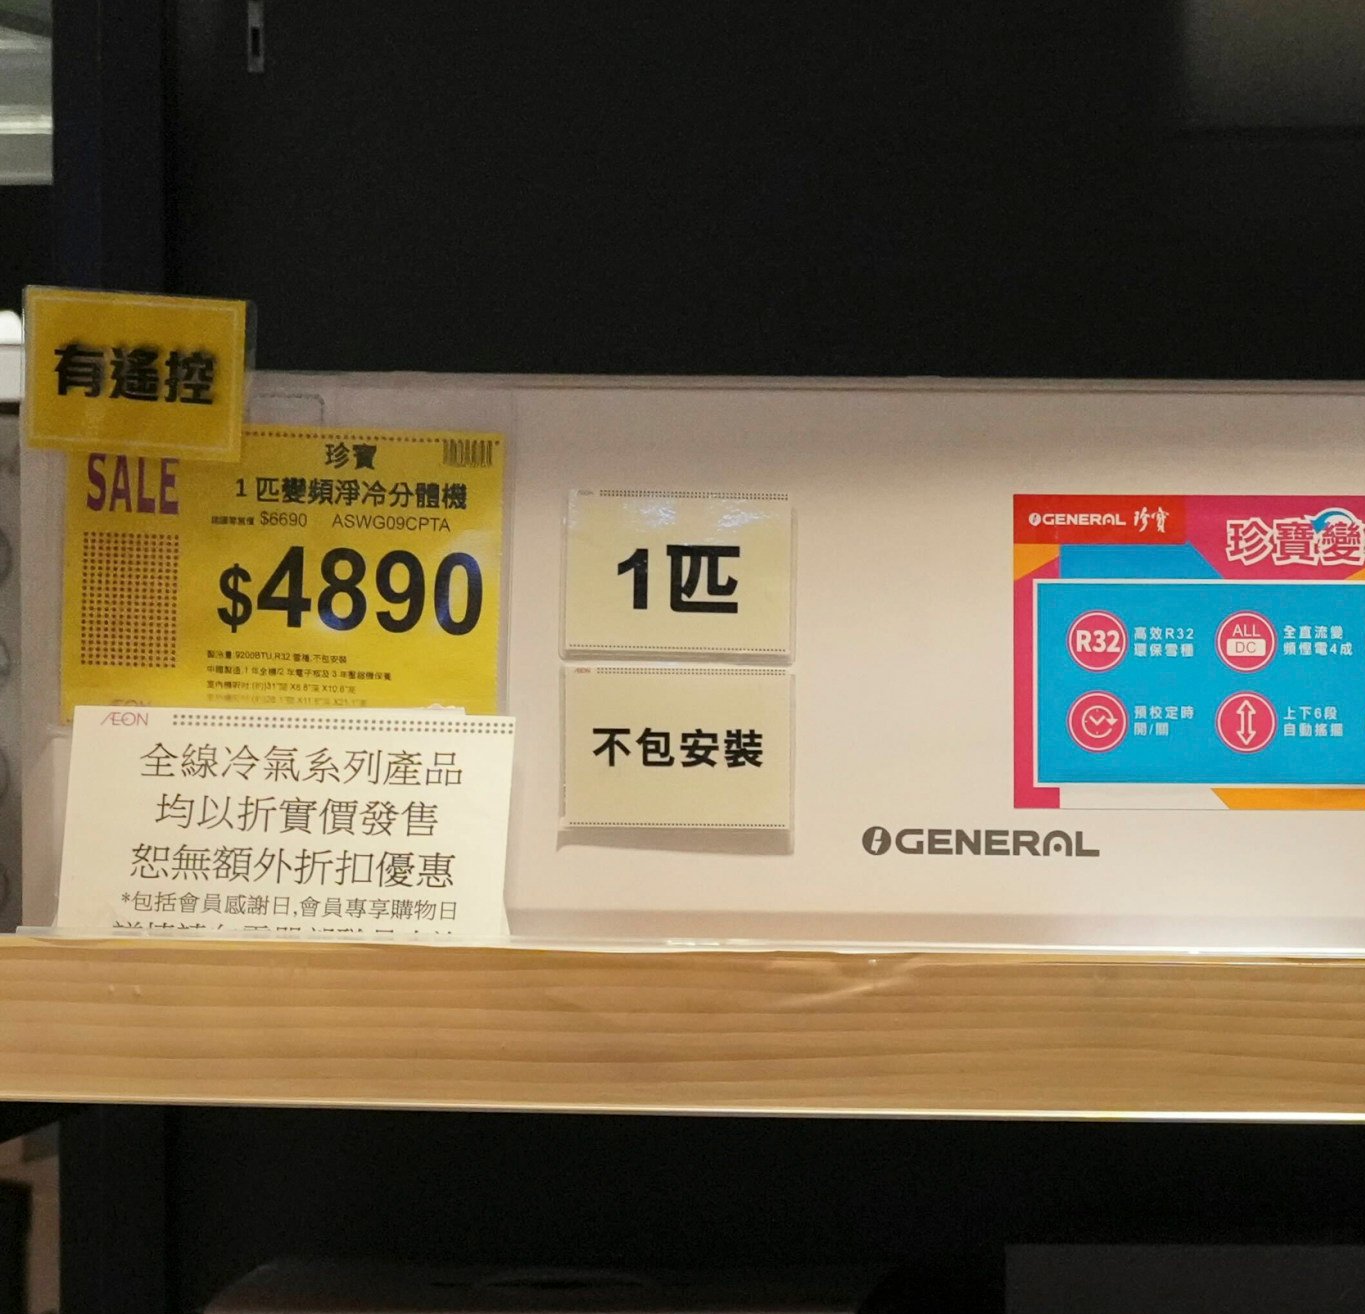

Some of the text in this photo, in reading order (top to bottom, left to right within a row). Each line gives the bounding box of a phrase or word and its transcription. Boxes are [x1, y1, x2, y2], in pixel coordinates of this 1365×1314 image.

[53, 342, 217, 405] 有遙控
[325, 443, 377, 470] 珍寶
[84, 452, 180, 515] SALE
[235, 477, 467, 511] 1 匹變頻淨冷分體機
[260, 510, 451, 533] $6690 ASWG09CPTA
[1042, 512, 1126, 528] GENERAL
[217, 546, 483, 635] $4890
[618, 544, 740, 613] 1匹
[1076, 628, 1121, 653] R32
[1134, 626, 1194, 641] 高效R32
[1233, 624, 1261, 638] ALL
[1283, 626, 1343, 641] 全直流變
[1134, 641, 1194, 658] 環保雪種
[1235, 640, 1256, 654] DC
[1134, 705, 1194, 720] 預校定時
[1283, 706, 1338, 722] 上下6段
[1134, 722, 1169, 738] 開/關
[1283, 722, 1344, 738] 自動搖擺
[593, 728, 763, 768] 不包安裝
[140, 742, 462, 787] 全線冷氣系列產品
[155, 793, 438, 838] 均以折實價發售
[895, 828, 1100, 857] GENERAL
[131, 844, 456, 888] 恕無額外折扣優惠
